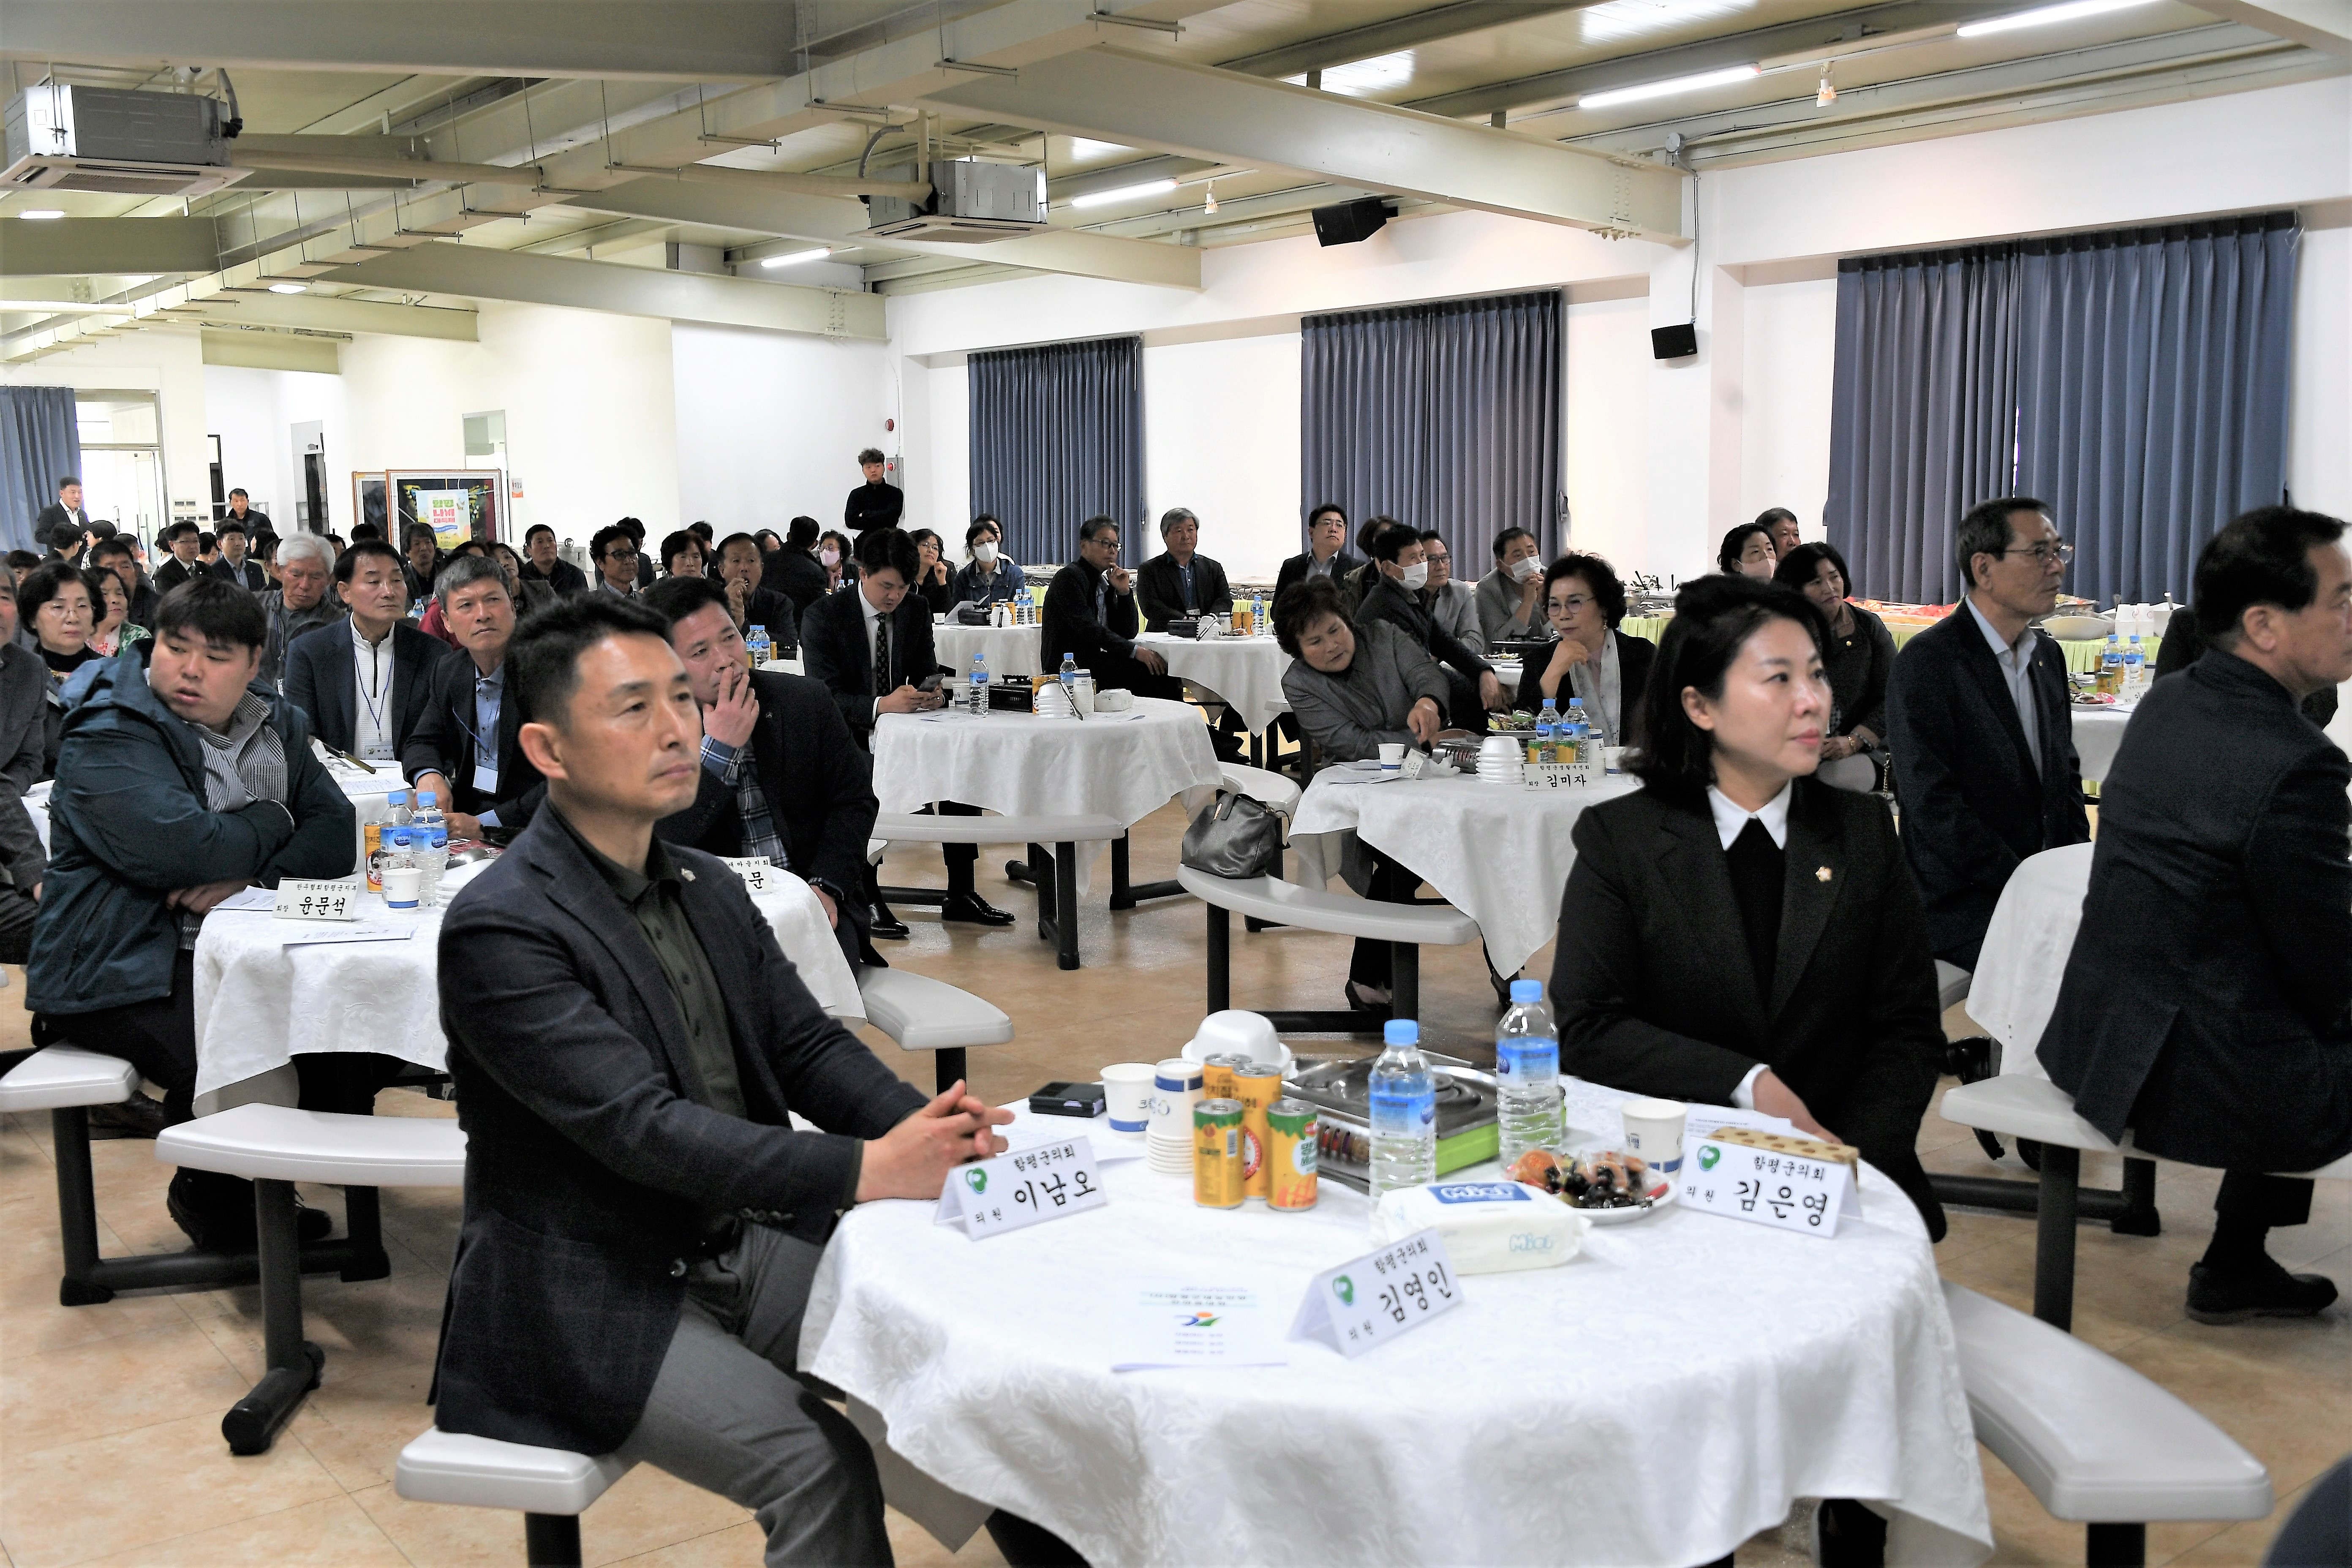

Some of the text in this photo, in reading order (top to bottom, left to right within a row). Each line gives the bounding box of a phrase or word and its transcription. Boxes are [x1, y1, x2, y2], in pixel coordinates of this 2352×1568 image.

[1547, 774, 1587, 787] 김미자
[276, 896, 346, 916] 회장 윤문석
[1014, 1144, 1075, 1172] 함평군의회
[1753, 1155, 1825, 1181] 함평군의회
[1014, 1170, 1097, 1212] 이남오
[1733, 1179, 1827, 1226] 김은영
[1374, 1237, 1427, 1274] 함평군의회
[1379, 1261, 1451, 1323] 김영인
